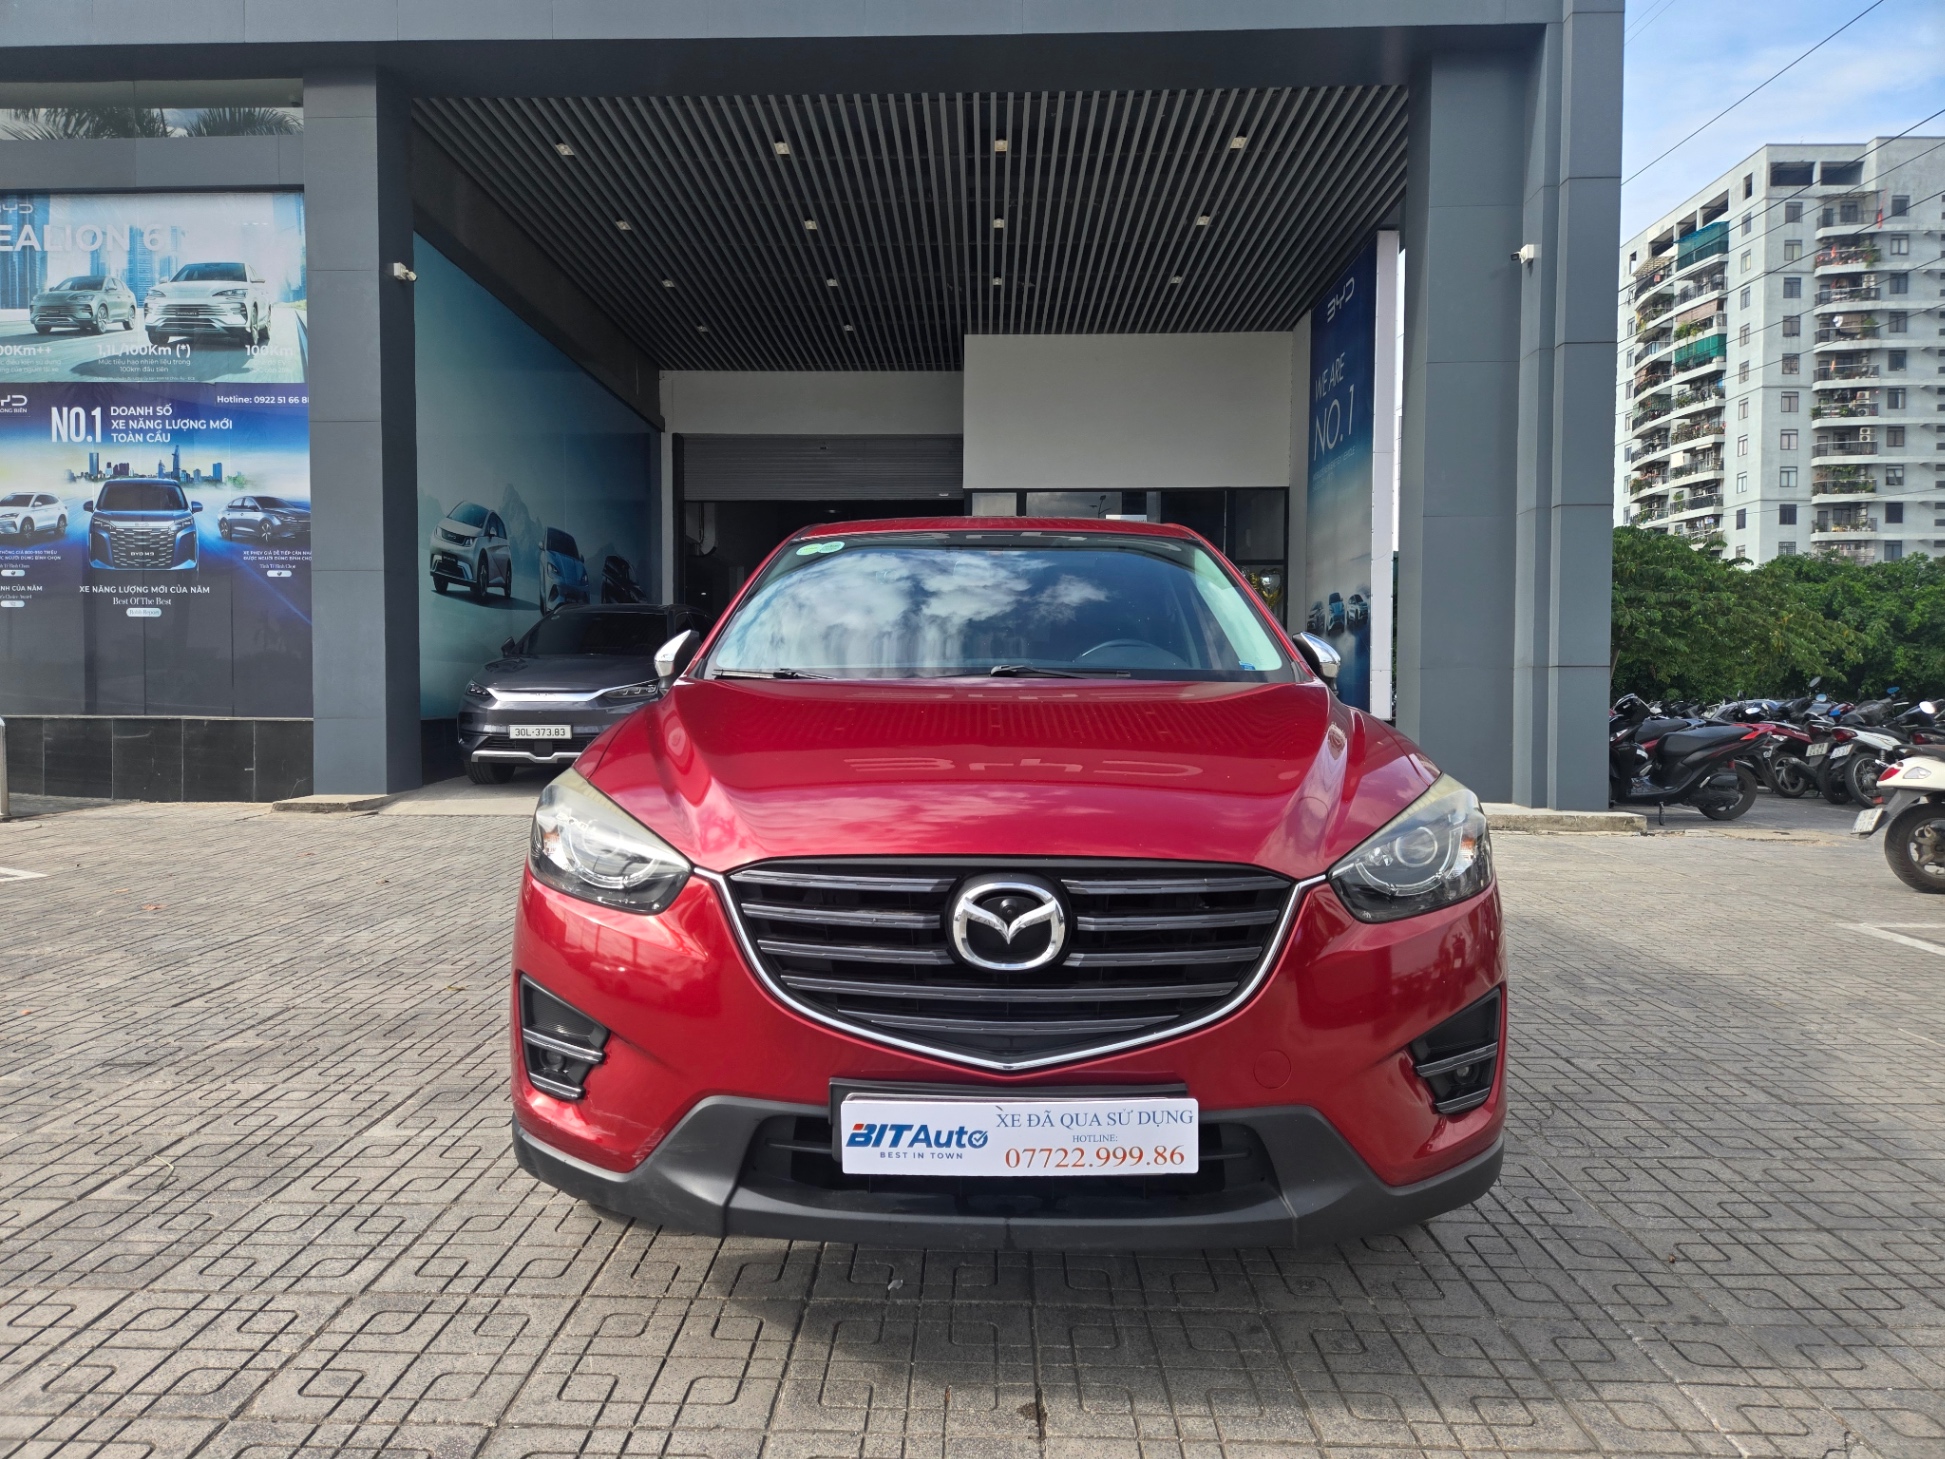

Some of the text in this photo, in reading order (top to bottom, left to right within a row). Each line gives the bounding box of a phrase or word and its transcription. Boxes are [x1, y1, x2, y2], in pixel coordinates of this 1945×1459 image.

[143, 224, 165, 252] 6
[1327, 276, 1355, 323] BYD
[245, 344, 293, 356] 100Km
[1315, 352, 1346, 402] WE ARE
[217, 394, 310, 404] Hotline: 0922 51 66 8
[110, 403, 172, 416] DOANH SỐ
[51, 406, 102, 443] NO.1
[111, 417, 233, 432] XE NĂNG LƯỢNG MỚI
[111, 429, 171, 443] TOÀN CẦU
[12, 584, 26, 592] CỦA
[27, 584, 43, 592] NĂM
[92, 584, 116, 594] NĂNG
[119, 584, 148, 595] LƯỢNG
[151, 584, 168, 594] MỚI
[170, 584, 188, 593] CỦA
[190, 584, 210, 594] NĂM
[113, 596, 171, 605] Best Of The Best
[996, 1107, 1194, 1131] XE ĐÃ QUA SỬ DỤNG
[1072, 1134, 1118, 1143] HOTLINE:
[880, 1151, 908, 1159] BEST
[930, 1152, 963, 1160] TOWN
[1005, 1144, 1186, 1169] 07722.999.86
